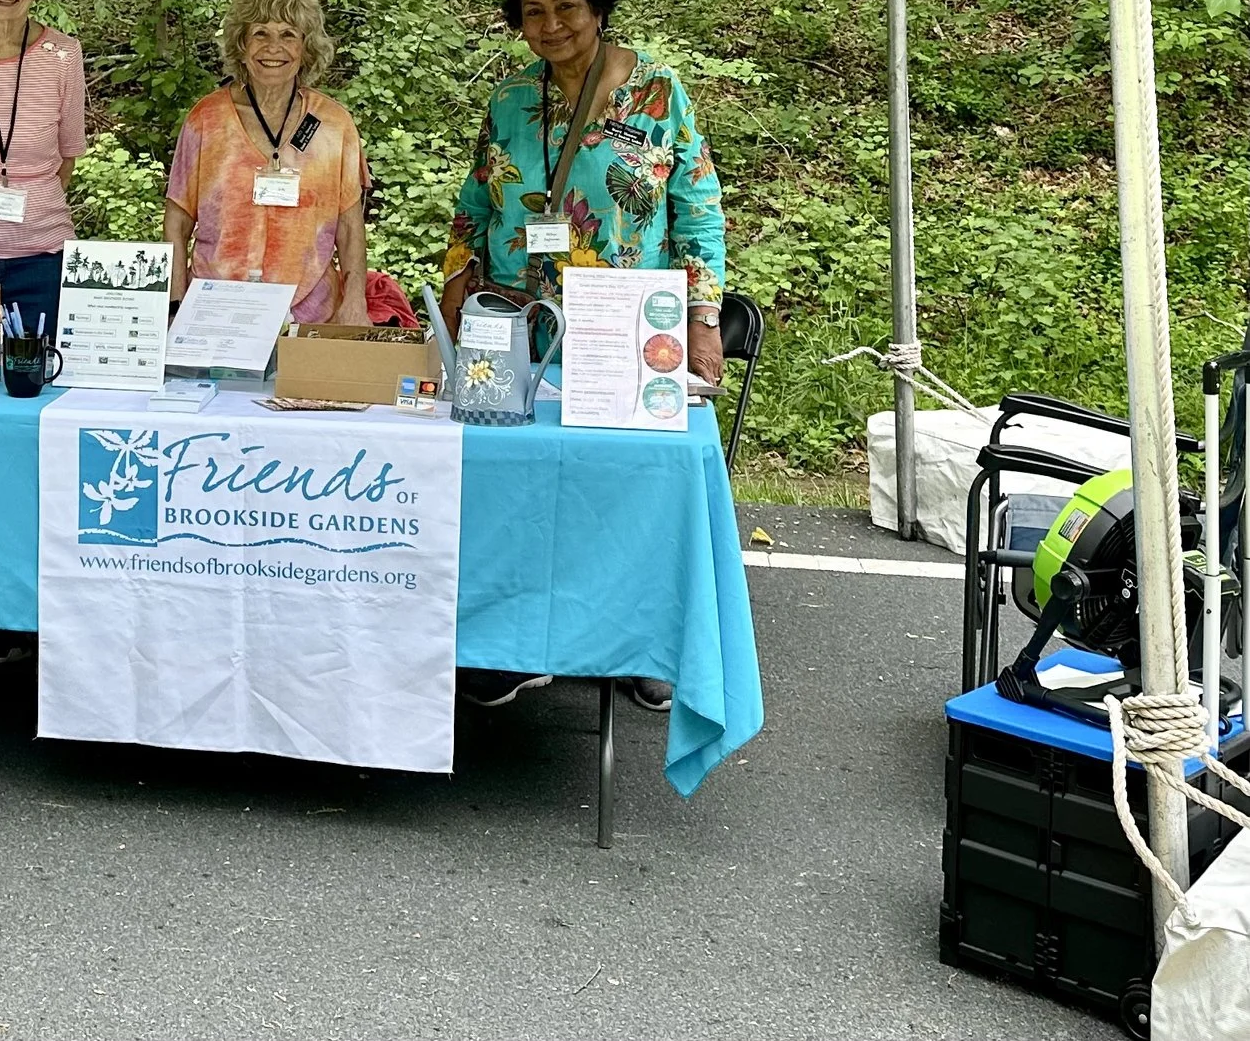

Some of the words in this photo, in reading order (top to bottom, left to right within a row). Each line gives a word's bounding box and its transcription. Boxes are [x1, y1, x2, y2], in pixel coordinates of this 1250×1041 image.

[162, 432, 405, 502] Friends
[396, 491, 419, 504] OF
[165, 507, 299, 530] BROOKSIDE
[308, 513, 420, 536] GARDENS
[80, 554, 417, 590] www.friendsofbrooksidegardens.org
